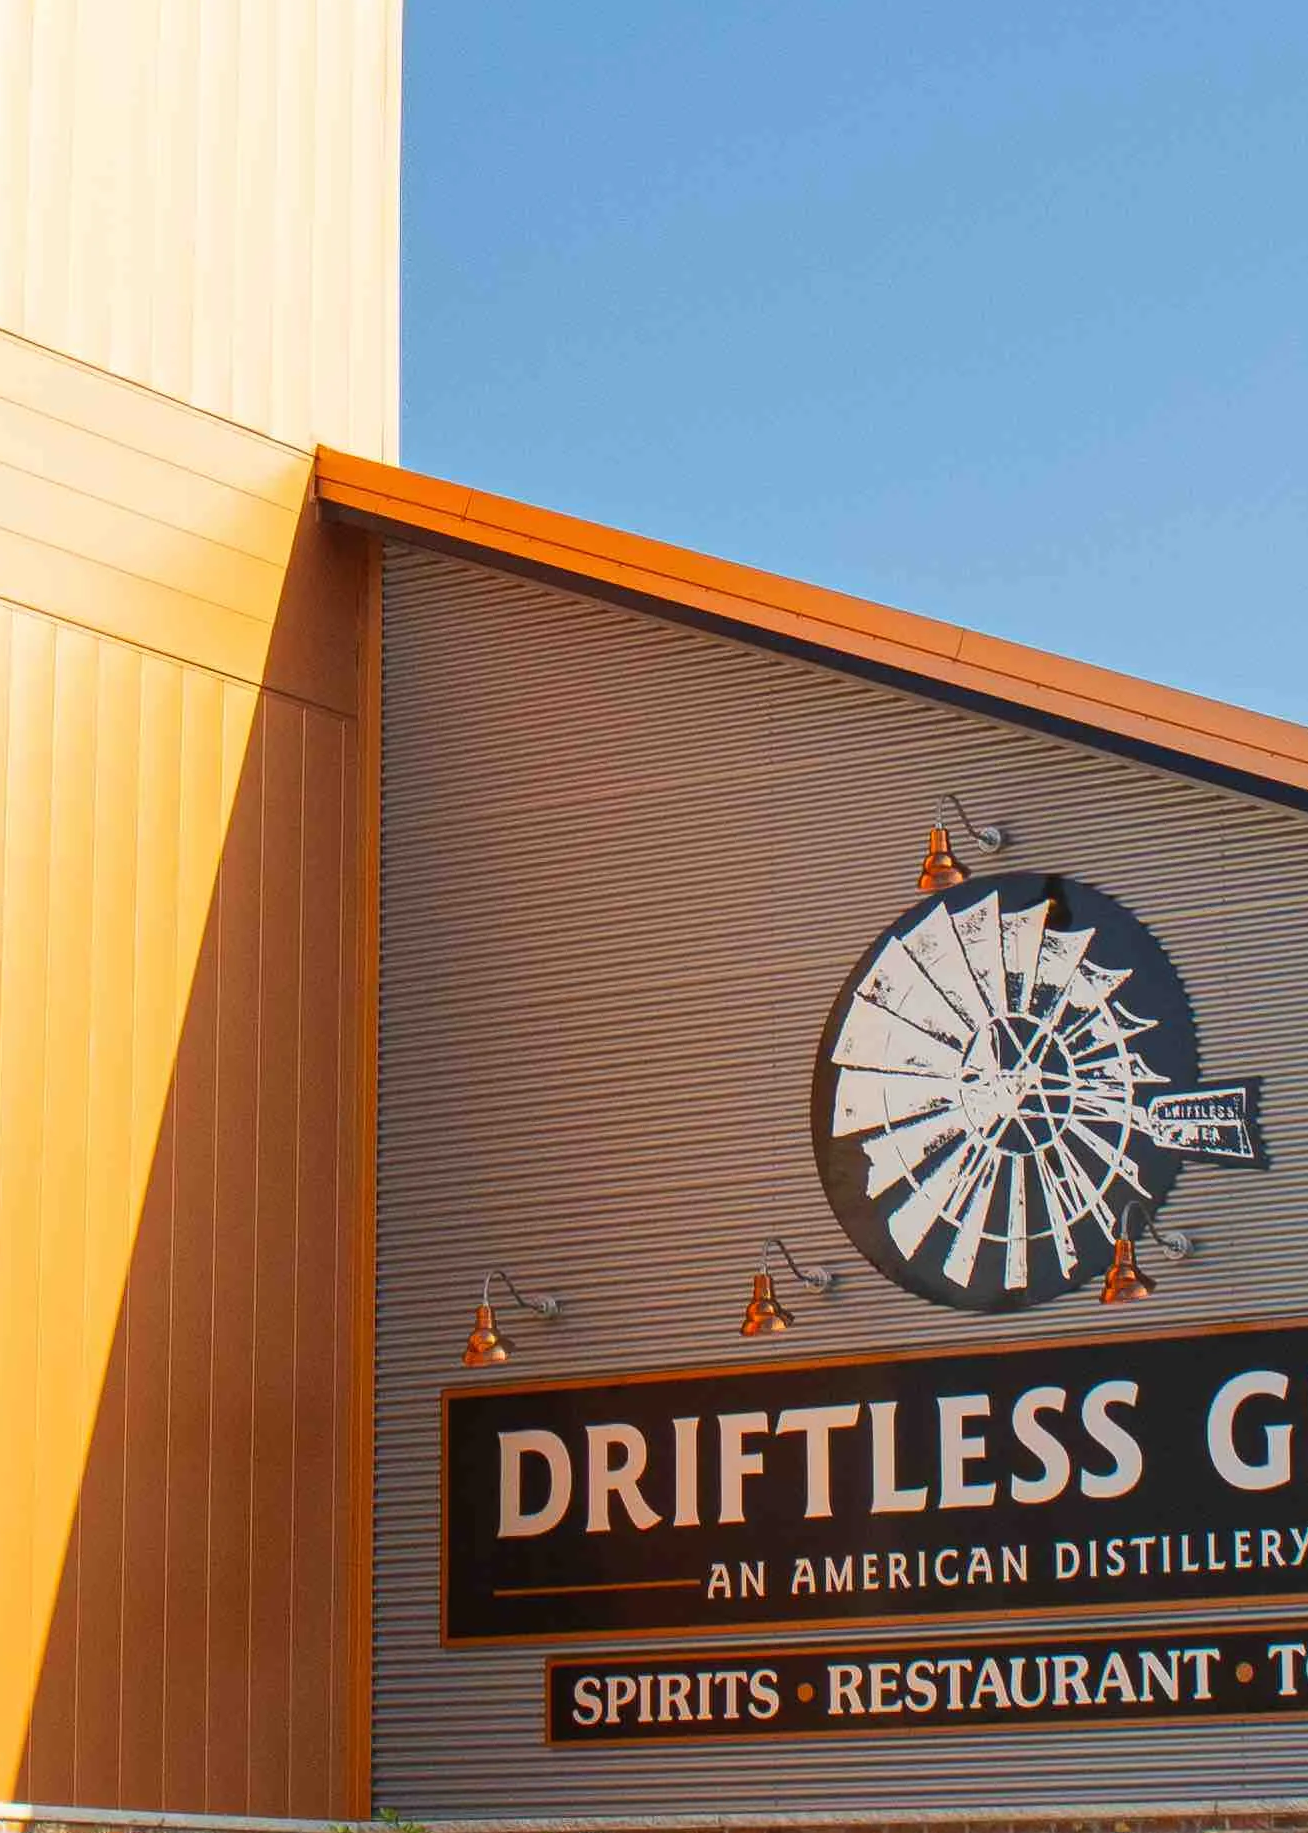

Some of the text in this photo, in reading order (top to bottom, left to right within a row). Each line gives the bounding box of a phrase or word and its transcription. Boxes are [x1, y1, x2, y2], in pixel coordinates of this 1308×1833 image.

[496, 1380, 1143, 1538] DRIFTLESS
[706, 1562, 765, 1599] AN
[790, 1545, 1027, 1594] AMERICAN
[571, 1669, 780, 1725] SPIRITS
[826, 1648, 1222, 1714] RESTAURANT
